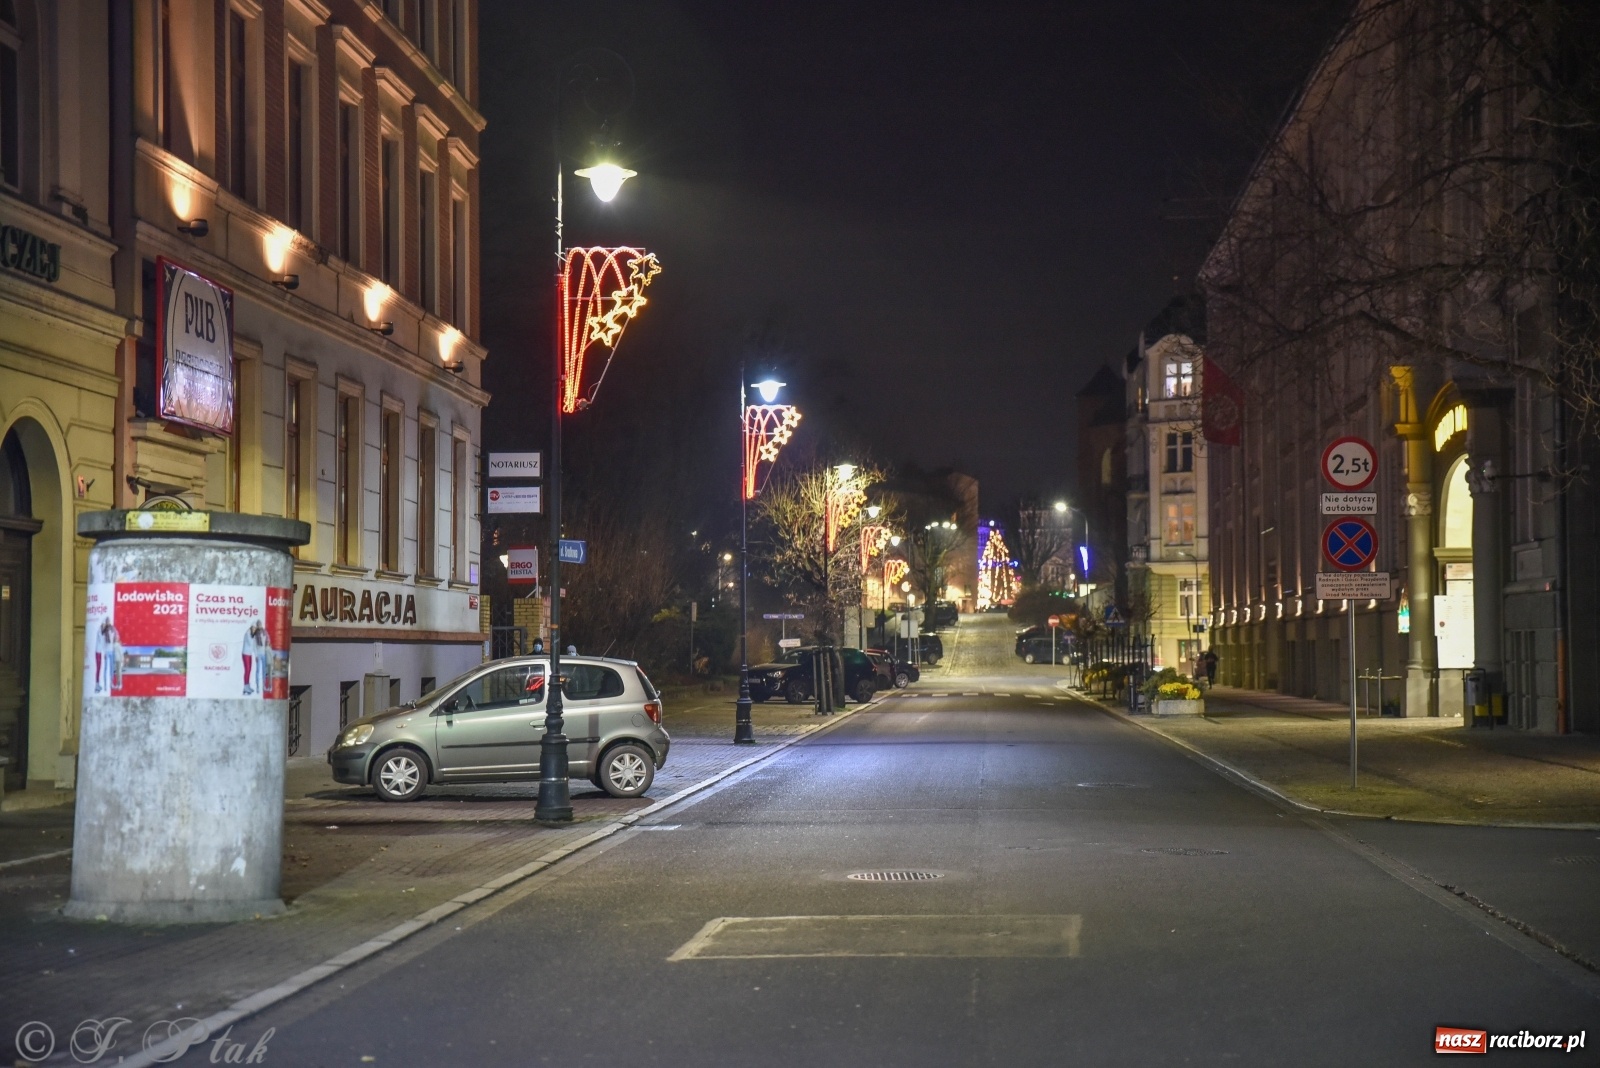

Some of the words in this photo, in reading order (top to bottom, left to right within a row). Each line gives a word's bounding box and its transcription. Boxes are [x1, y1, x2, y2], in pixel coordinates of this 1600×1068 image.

[184, 291, 216, 344] PUB
[490, 460, 539, 469] NOTARIUSZ
[1331, 453, 1370, 476] 2,5t
[1324, 495, 1340, 503] Nie
[1343, 495, 1376, 506] dotyczy
[1325, 504, 1374, 512] autobusów
[510, 561, 533, 569] ERGO
[117, 589, 184, 603] Lodowisko
[196, 593, 226, 604] Czas
[229, 596, 244, 604] na
[153, 603, 184, 615] 2021
[195, 604, 259, 618] inwestycje
